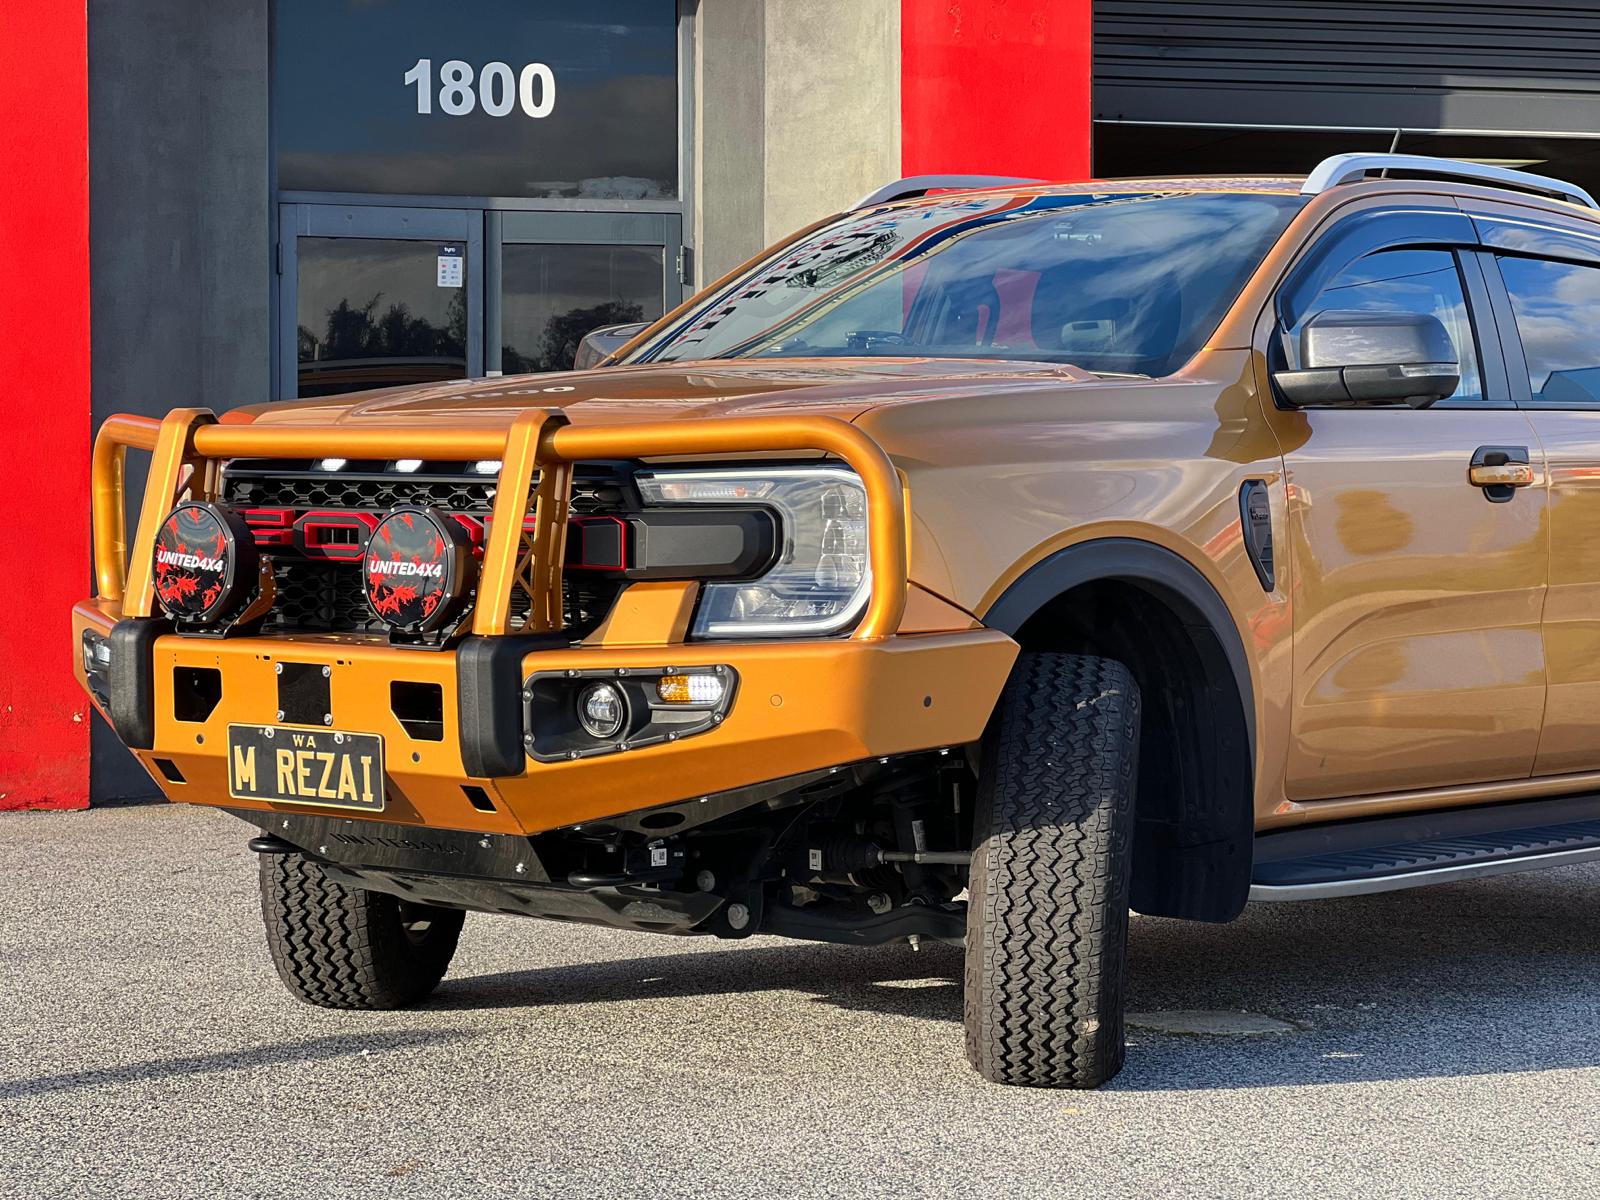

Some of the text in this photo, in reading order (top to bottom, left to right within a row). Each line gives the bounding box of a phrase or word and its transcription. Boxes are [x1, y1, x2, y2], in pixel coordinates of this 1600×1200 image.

[404, 59, 556, 118] 1800
[157, 550, 224, 572] UNITED4X4
[369, 560, 443, 578] UNITED4X4
[292, 734, 317, 749] WA
[233, 745, 374, 803] M REZAI
